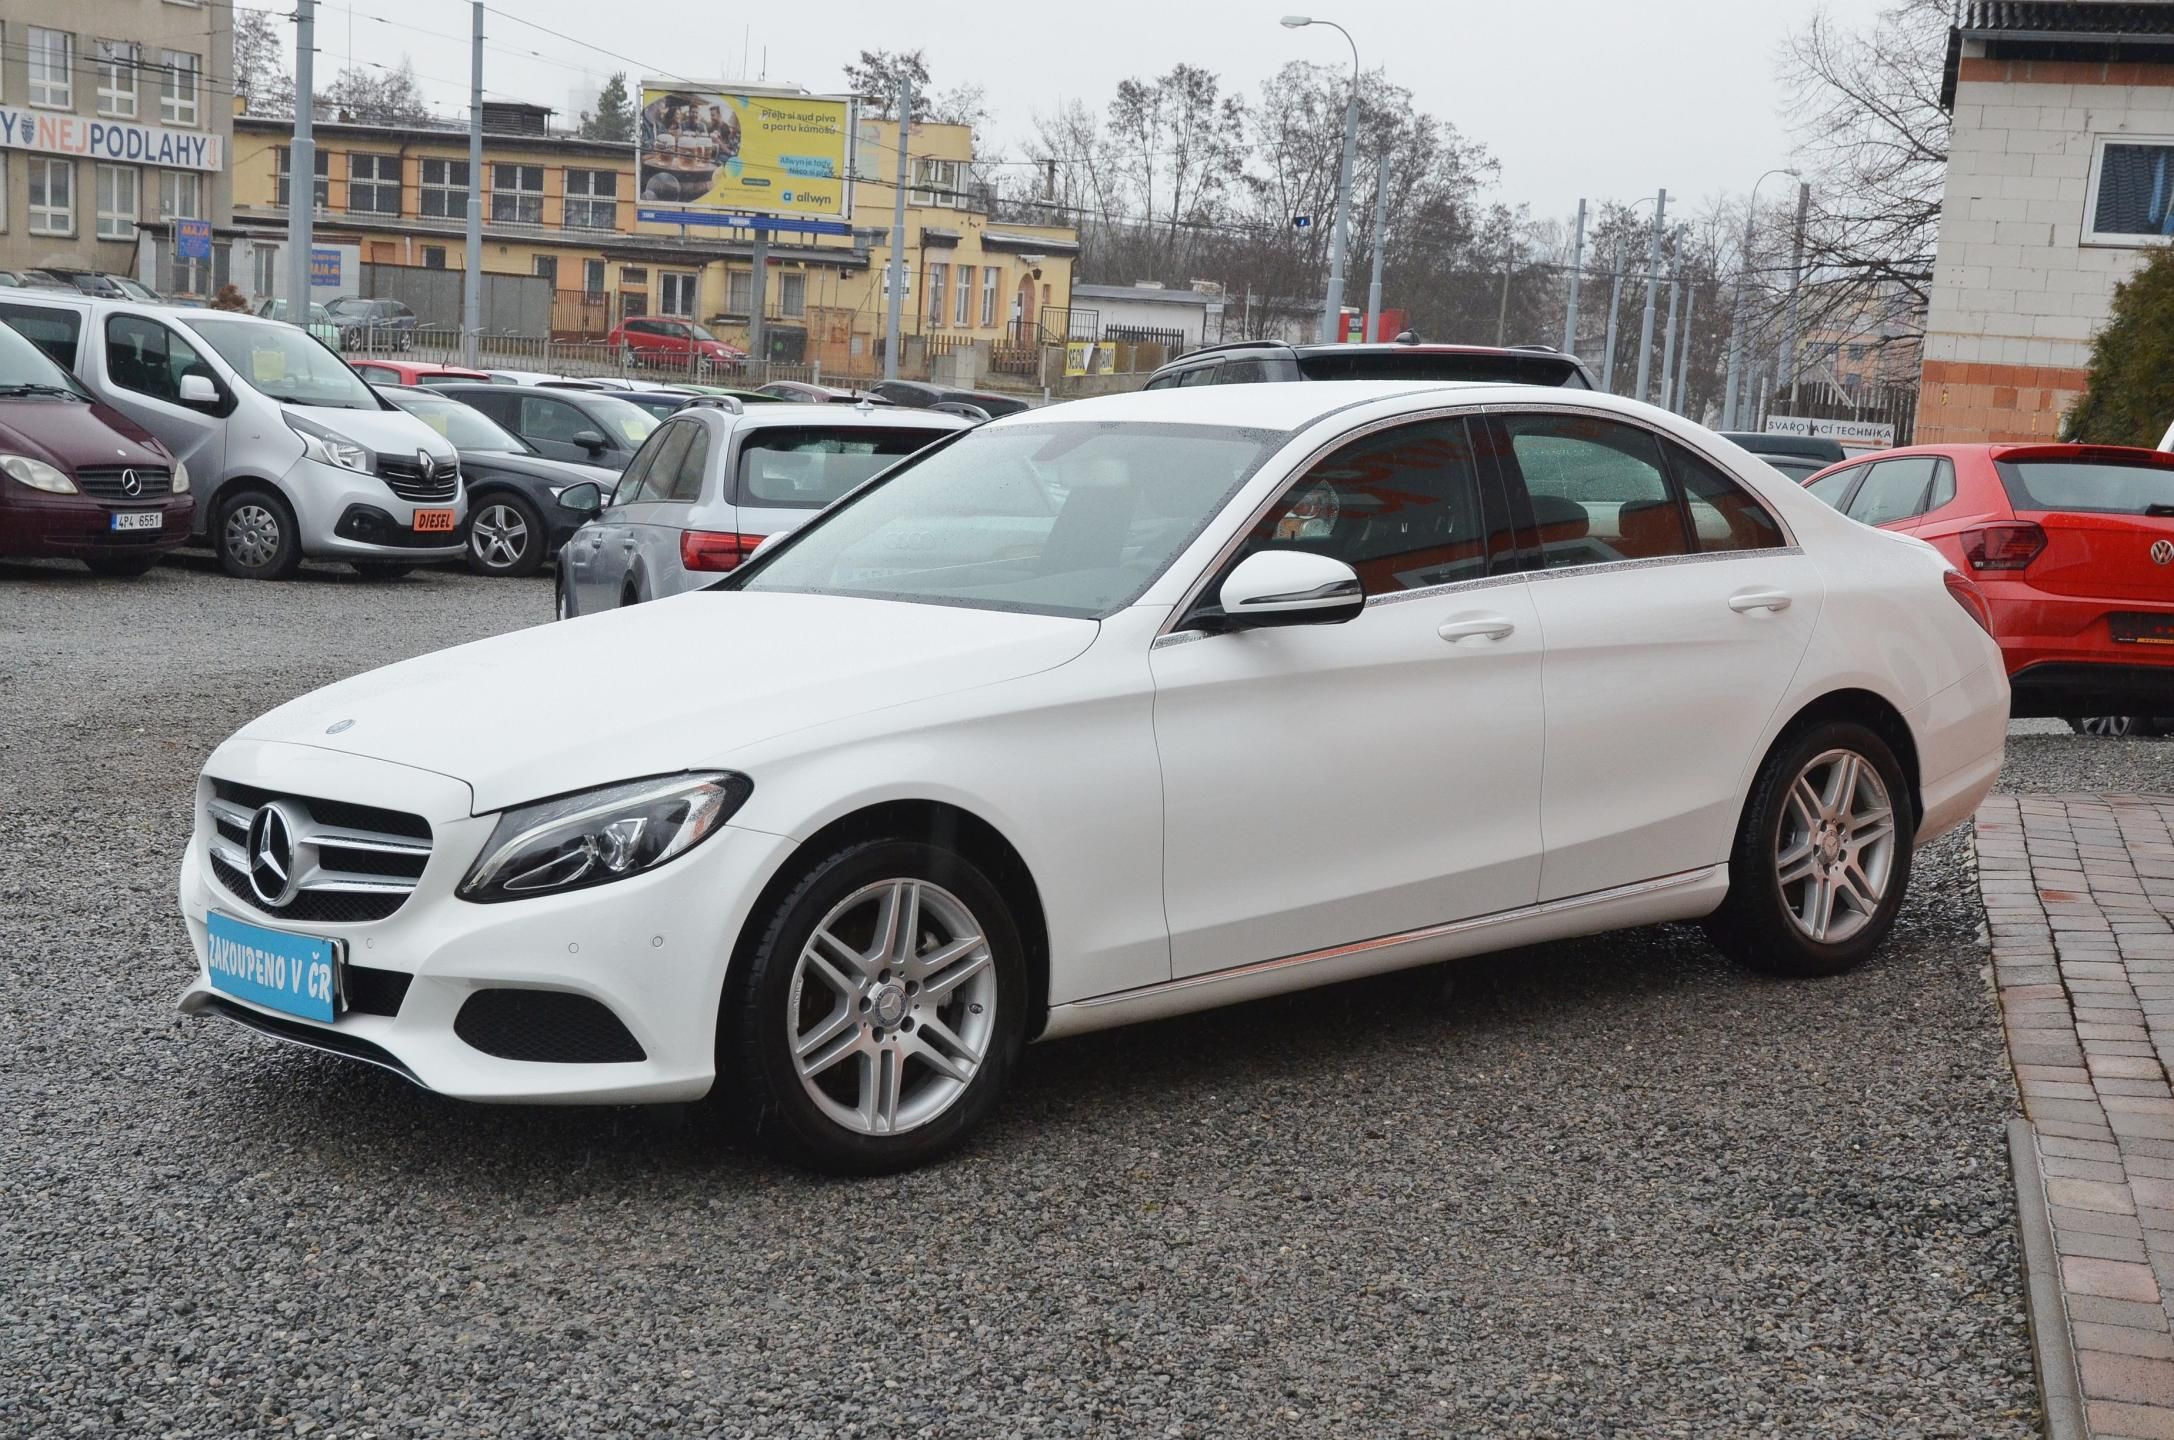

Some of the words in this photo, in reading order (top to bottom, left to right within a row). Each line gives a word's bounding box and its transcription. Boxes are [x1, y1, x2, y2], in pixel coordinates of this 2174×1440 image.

[815, 113, 836, 124] piva
[770, 123, 797, 133] partu
[39, 115, 207, 167] NEJPODLAHY
[796, 192, 832, 207] allwyn
[1836, 425, 1892, 438] TECHNIKA
[139, 514, 159, 527] 6551
[418, 513, 451, 529] DIESEL
[208, 933, 286, 990] ZAKOUPENO
[291, 957, 303, 994] V
[308, 951, 332, 1004] ČR
